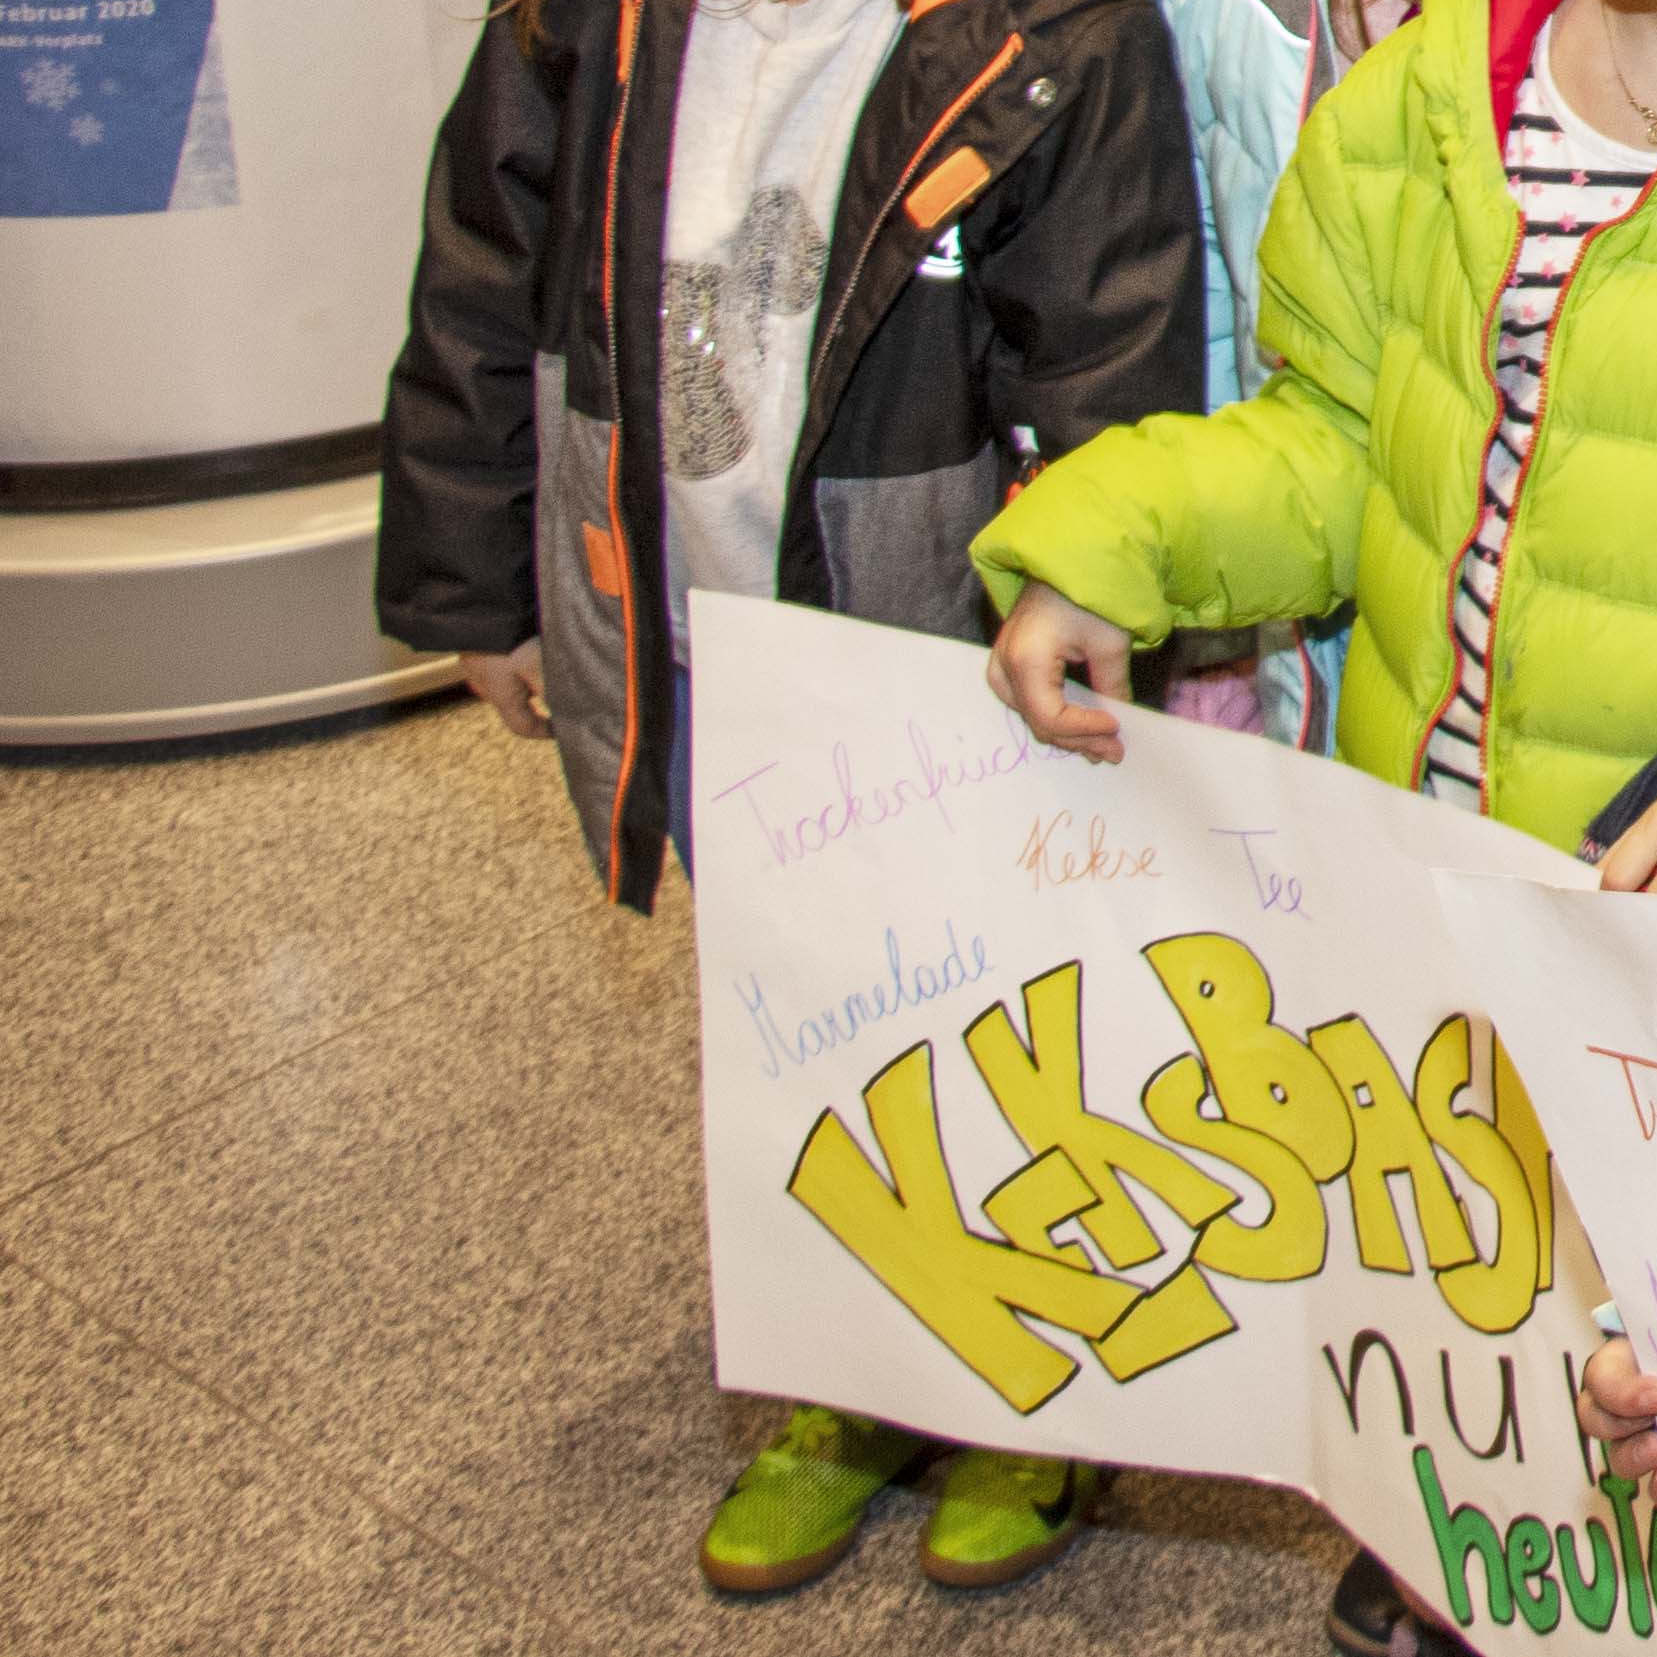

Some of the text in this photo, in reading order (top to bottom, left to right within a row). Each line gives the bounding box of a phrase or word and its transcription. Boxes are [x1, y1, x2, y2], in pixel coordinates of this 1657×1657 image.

[1015, 809, 1311, 922] Kekse Tee
[733, 917, 996, 1082] Marmelade
[786, 930, 1555, 1416] KEKSBAS
